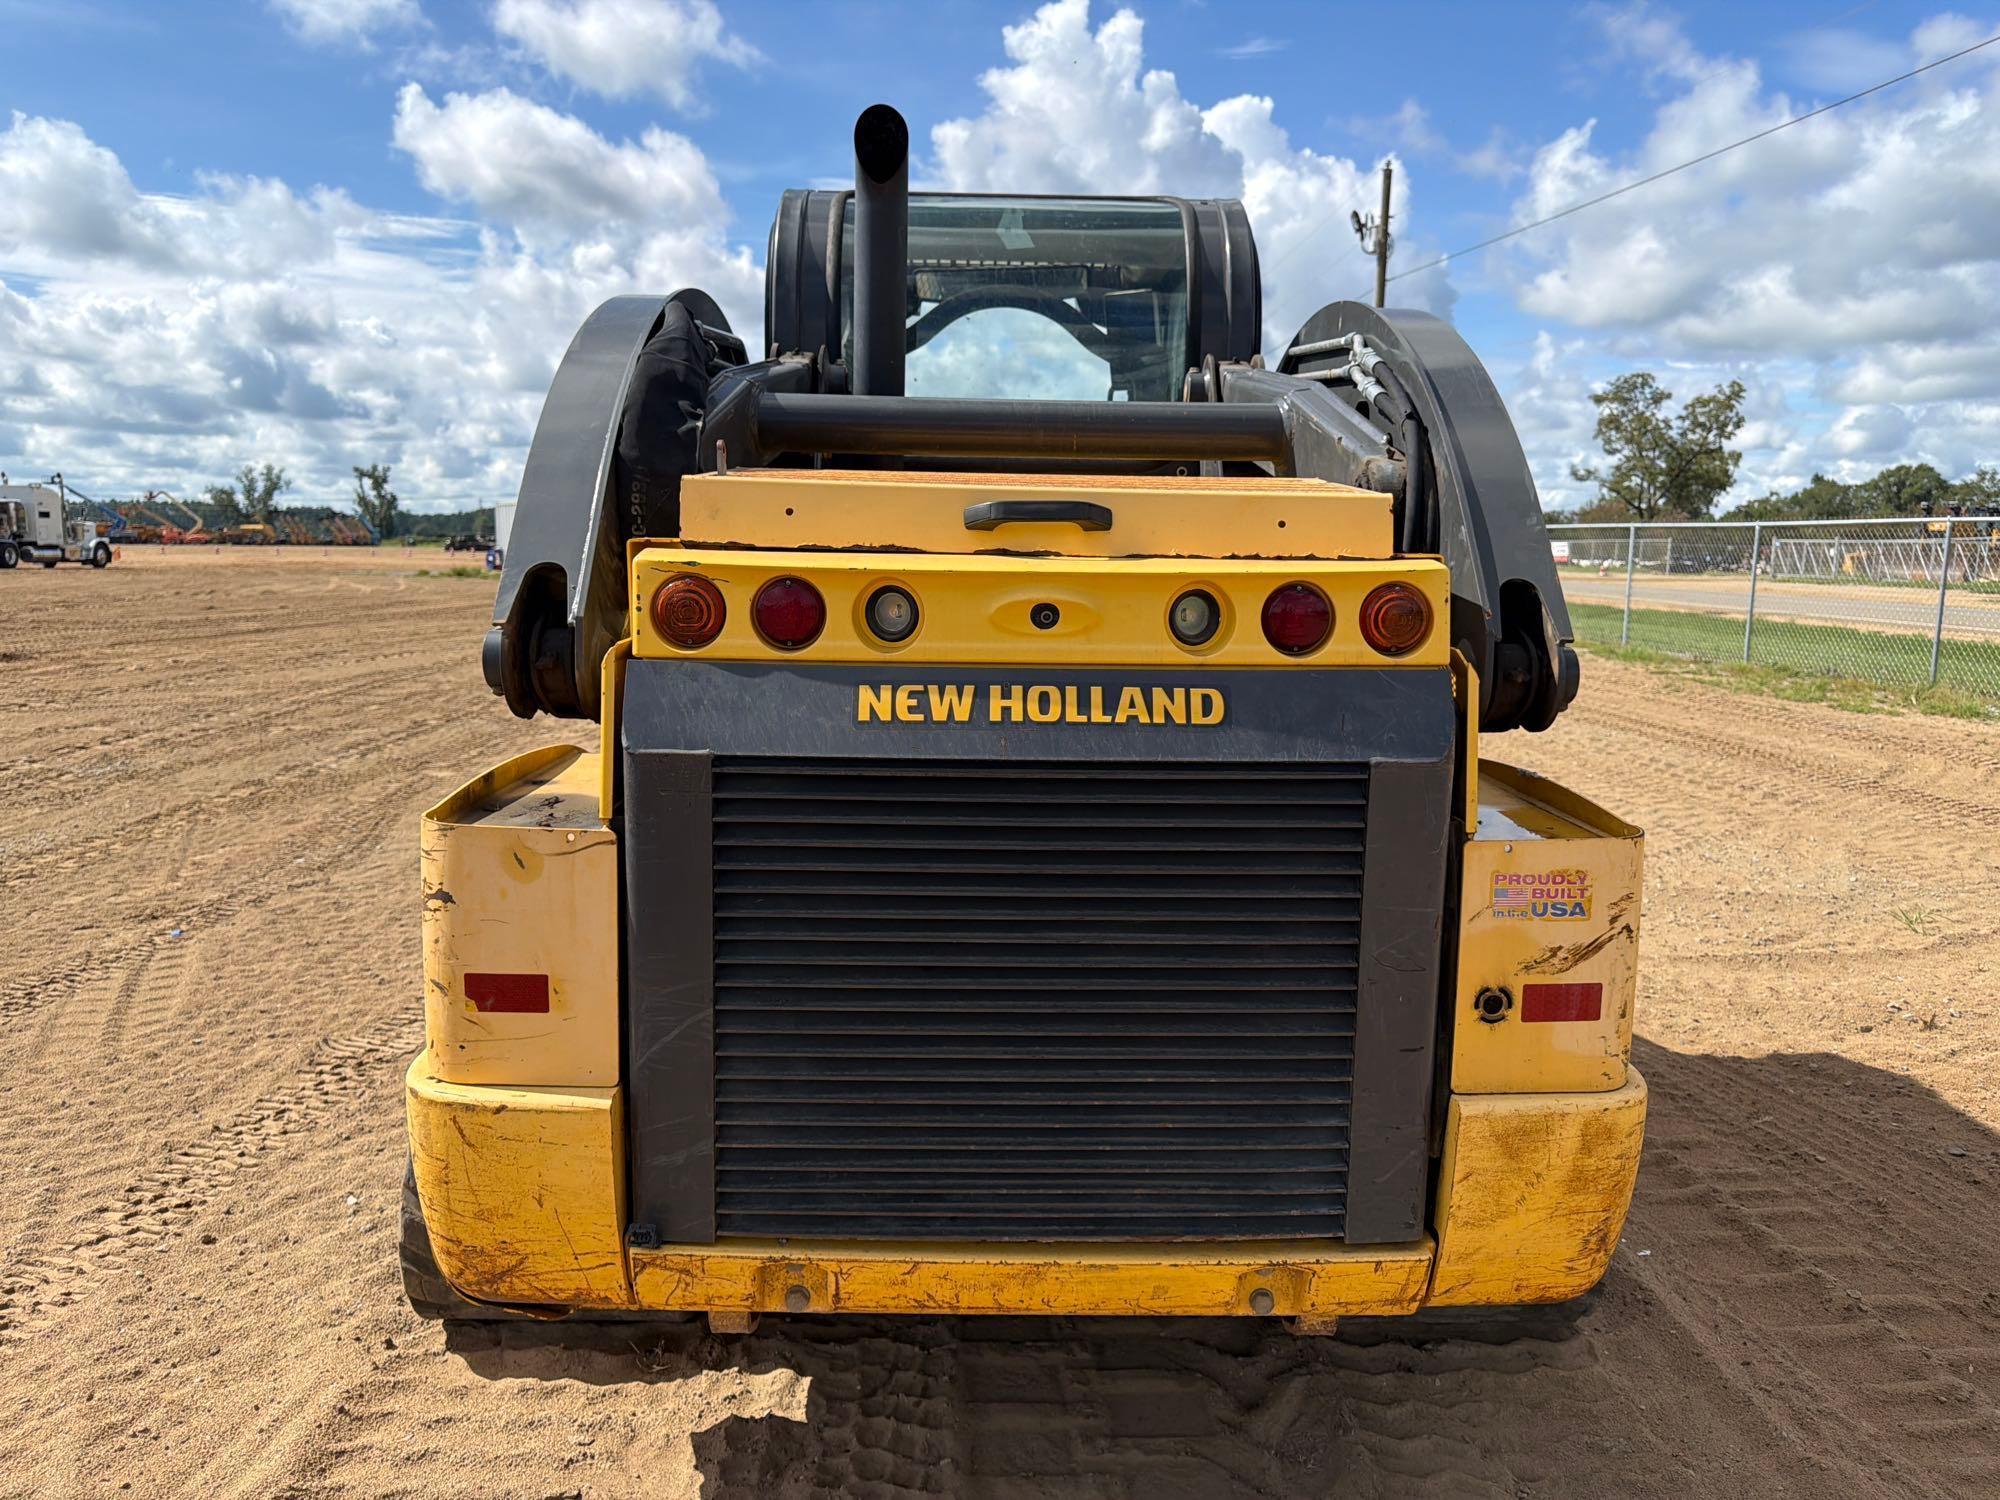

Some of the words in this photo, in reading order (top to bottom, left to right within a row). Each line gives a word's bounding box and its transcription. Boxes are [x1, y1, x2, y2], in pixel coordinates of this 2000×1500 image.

[857, 684, 975, 722] NEW
[989, 685, 1225, 725] HOLLAND
[1494, 874, 1587, 885] PROUDLY
[1531, 888, 1588, 899] BUILT
[1531, 902, 1587, 917] USA
